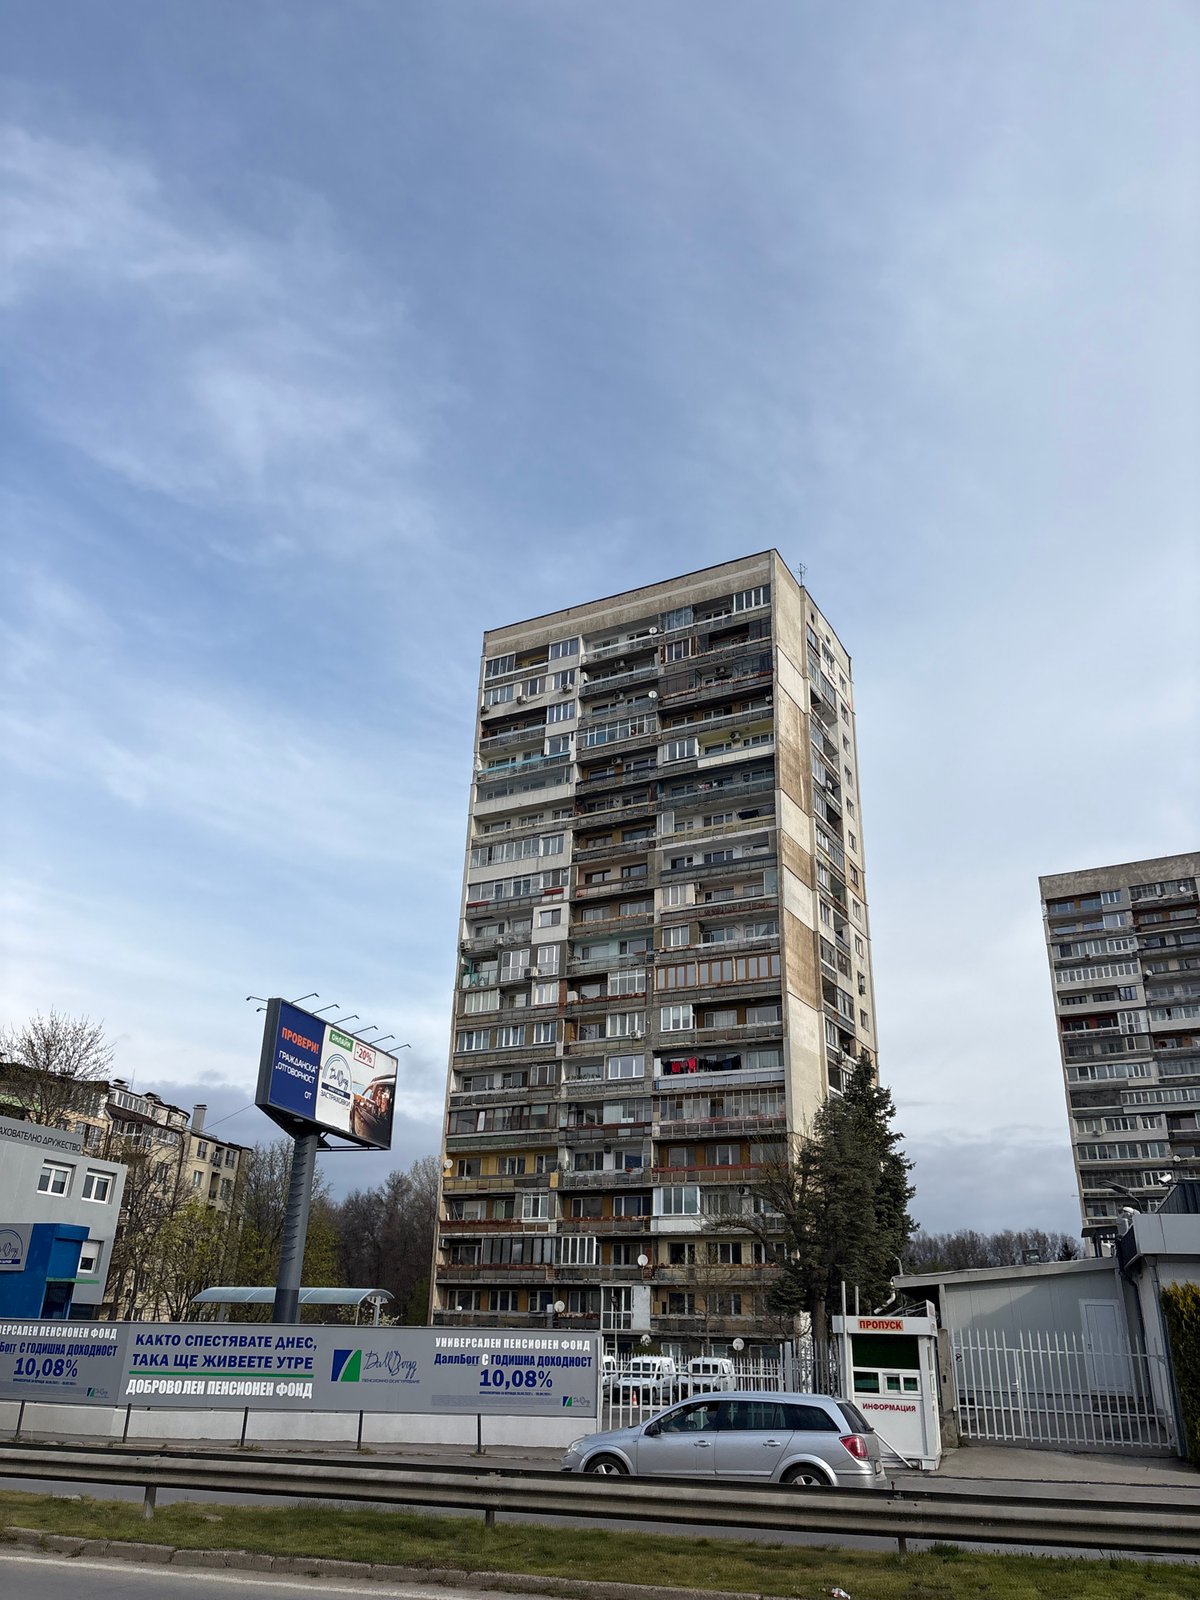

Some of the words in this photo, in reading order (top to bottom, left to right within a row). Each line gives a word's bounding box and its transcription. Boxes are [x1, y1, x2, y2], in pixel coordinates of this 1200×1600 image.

[281, 1026, 320, 1054] ПРОВЕРИ!
[356, 1048, 373, 1064] -20%
[304, 1090, 312, 1100] ОТ
[42, 1136, 81, 1152] ДРУЖЕСТВО
[39, 1325, 88, 1338] ПЕНСИОНЕН
[90, 1328, 118, 1340] ФОНД
[859, 1320, 903, 1330] ПРОПУСК
[19, 1342, 26, 1353] С
[26, 1342, 65, 1355] ГОДИШНА
[66, 1344, 118, 1357] ДОХОДНОСТ
[135, 1334, 181, 1346] КАКТО
[184, 1334, 273, 1348] СПЕСТЯВАТЕ
[275, 1336, 317, 1351] ДНЕС,
[435, 1337, 501, 1348] УНИВЕРСАЛЕН
[503, 1338, 559, 1350] ПЕНСИОНЕН
[561, 1340, 591, 1351] ФОНД
[13, 1357, 79, 1379] 10,08%
[132, 1353, 169, 1366] ТАКА
[173, 1354, 199, 1369] ЩЕ
[202, 1354, 273, 1368] ЖИВЕЕТЕ
[276, 1356, 314, 1369] УТРЕ
[434, 1353, 480, 1366] ДаллБогг
[490, 1354, 535, 1367] ГОДИШНА
[537, 1355, 592, 1368] ДОХОДНОСТ
[479, 1368, 553, 1390] 10,08%
[126, 1379, 206, 1396] ДОБРОВОЛЕН
[206, 1380, 274, 1396] ПЕНСИОНЕН
[275, 1382, 313, 1399] ФОНД
[862, 1402, 917, 1413] ИНФОРМАЦИЯ
